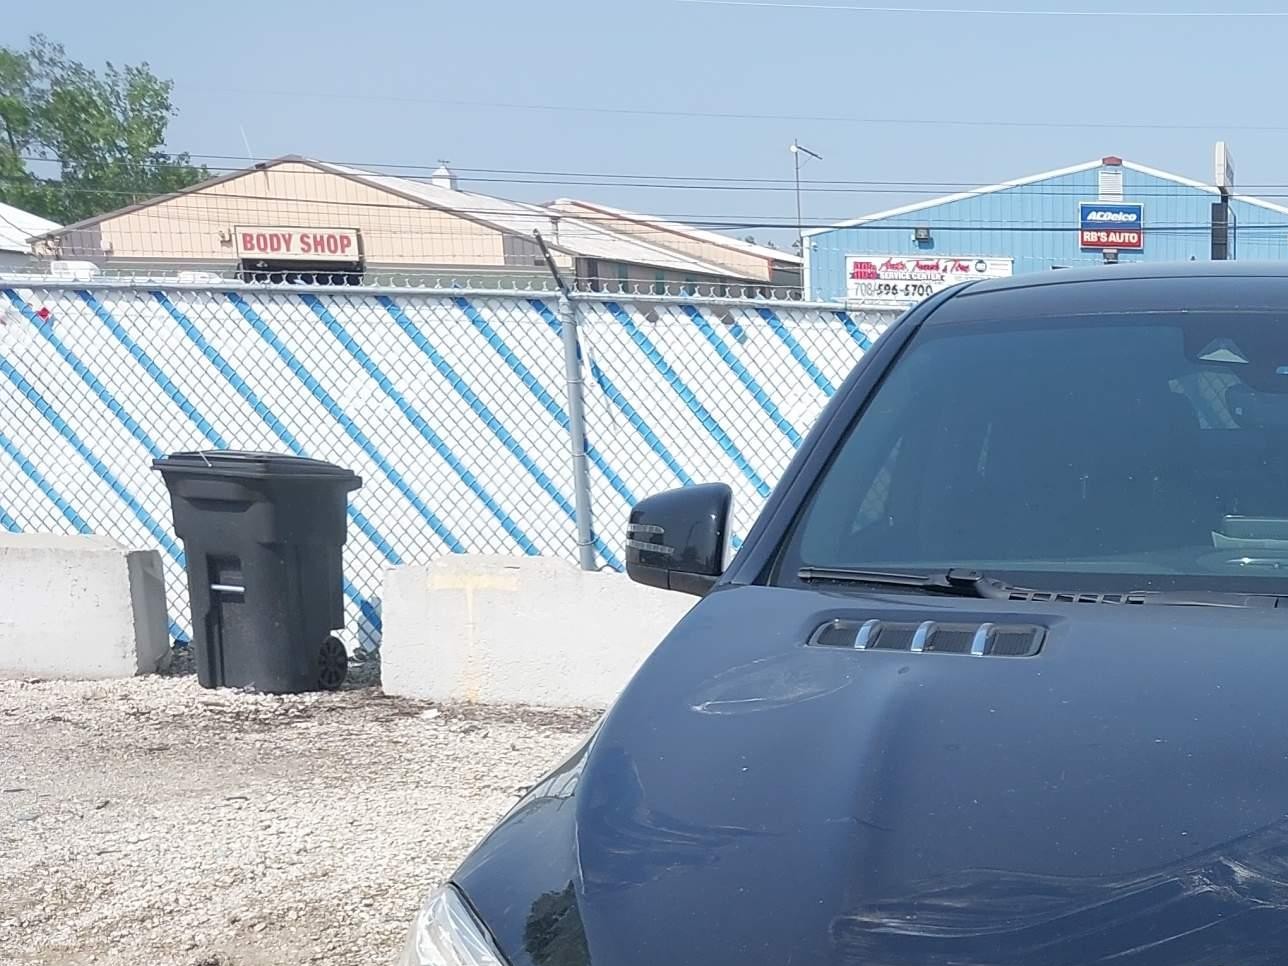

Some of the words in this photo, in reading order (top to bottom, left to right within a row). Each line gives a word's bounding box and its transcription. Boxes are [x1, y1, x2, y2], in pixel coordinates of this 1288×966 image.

[242, 233, 293, 252] BODY
[300, 233, 351, 253] SHOP
[1083, 231, 1107, 243] RB'S
[1109, 231, 1139, 243] AUTO
